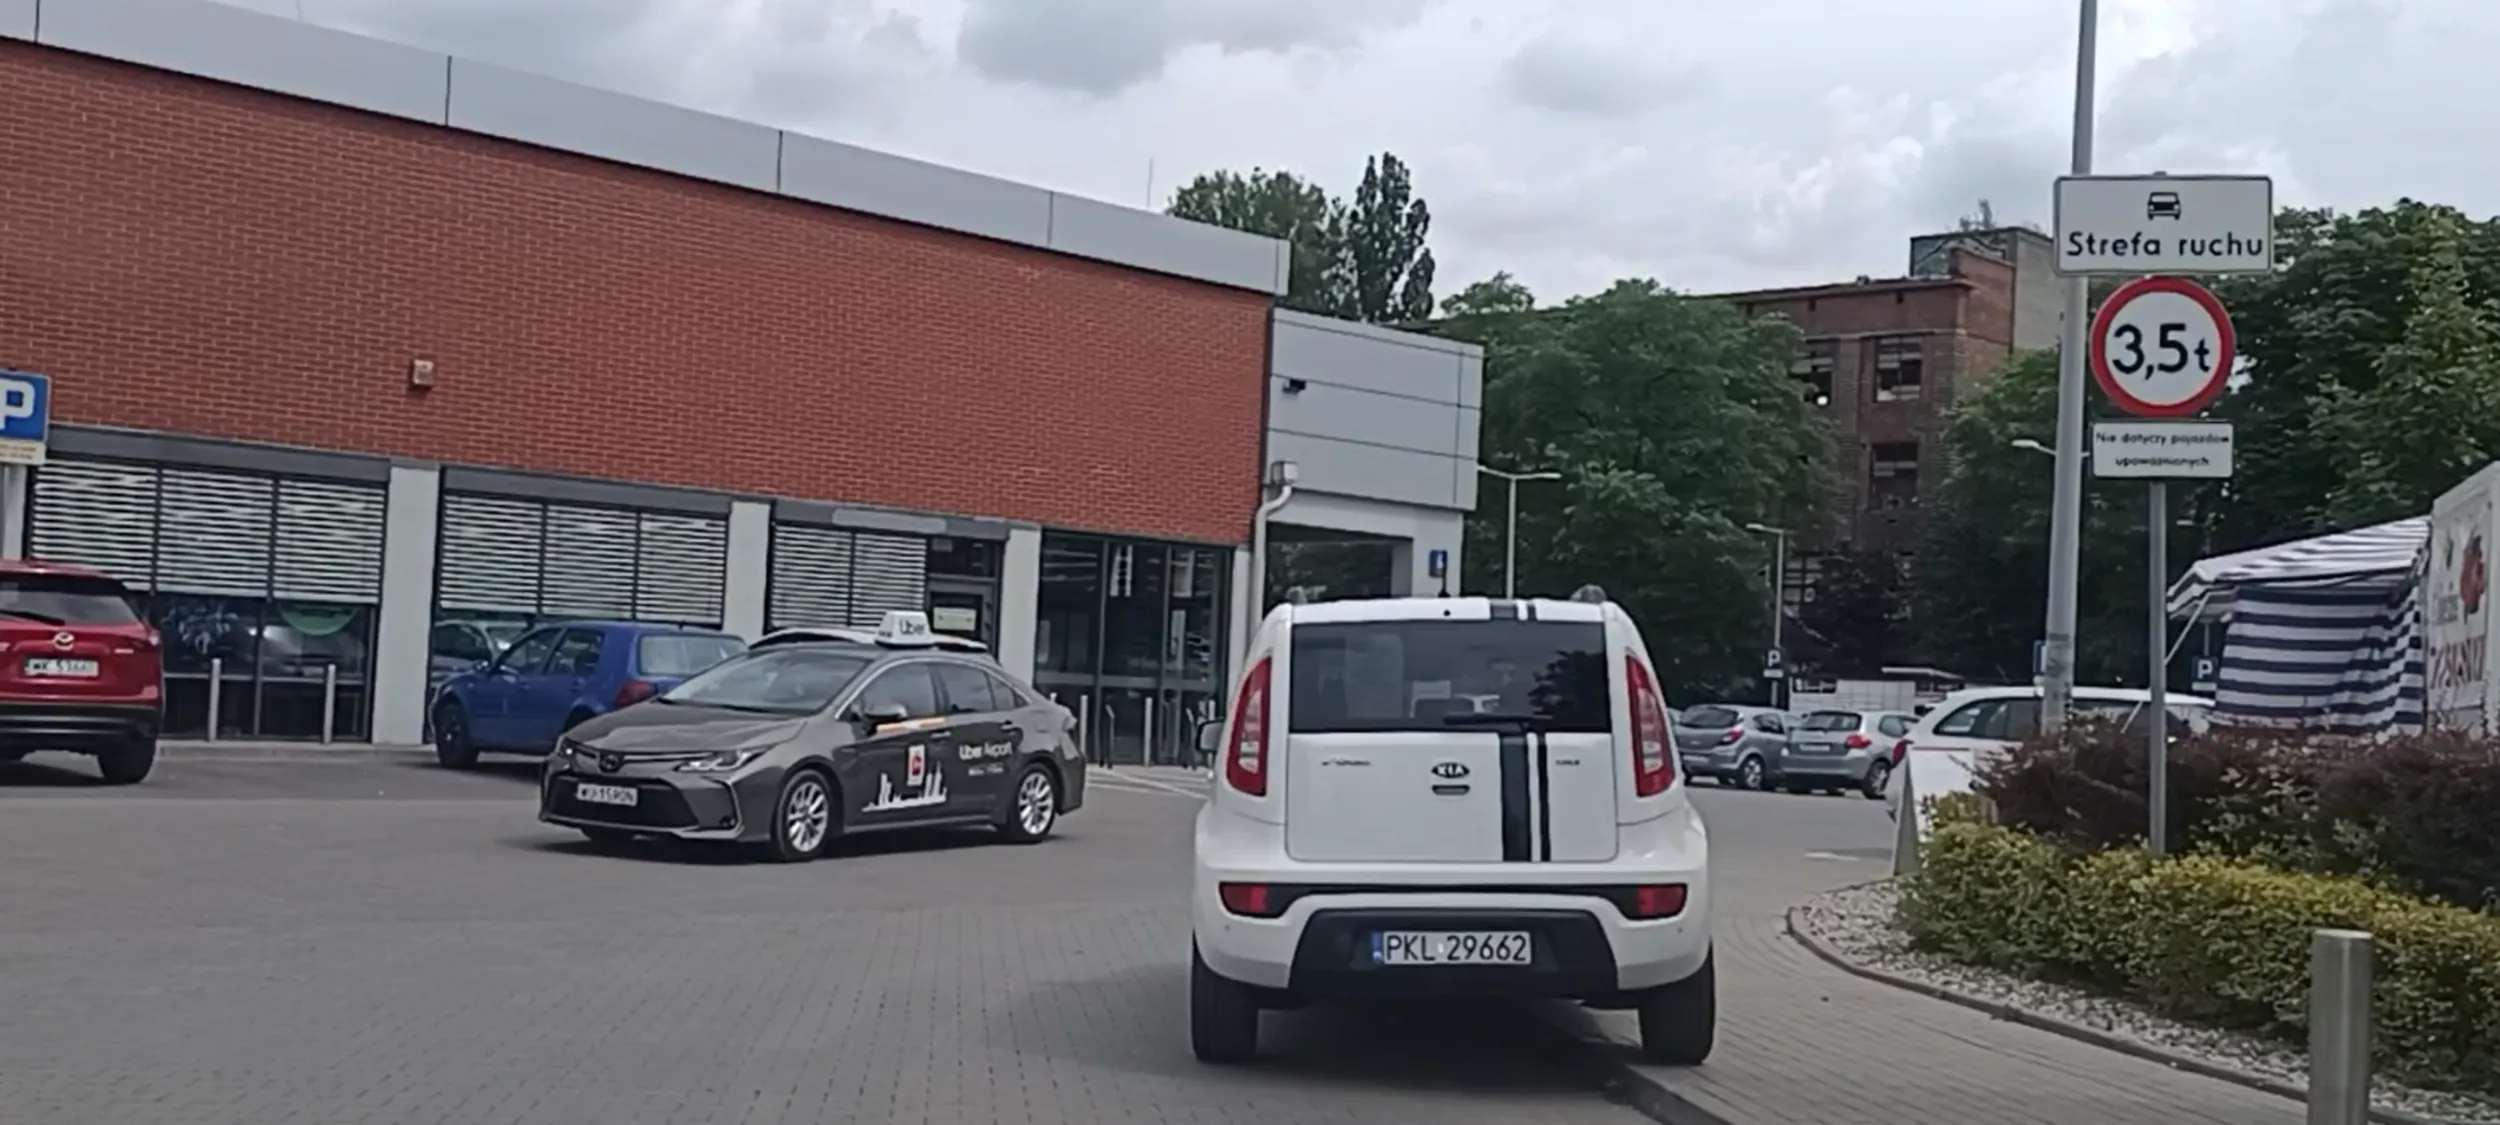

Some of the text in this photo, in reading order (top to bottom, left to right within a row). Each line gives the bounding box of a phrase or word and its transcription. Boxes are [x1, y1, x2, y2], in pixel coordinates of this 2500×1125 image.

[2066, 231, 2264, 257] Strefa ruchu
[2112, 322, 2211, 381] 3,5 t
[2096, 432, 2116, 443] Nie
[2121, 432, 2166, 446] dotyczy
[1768, 649, 1781, 667] P
[2197, 659, 2213, 679] P
[958, 744, 982, 760] Uber
[1435, 763, 1467, 778] KIA
[1386, 934, 1527, 961] PKL 29662
